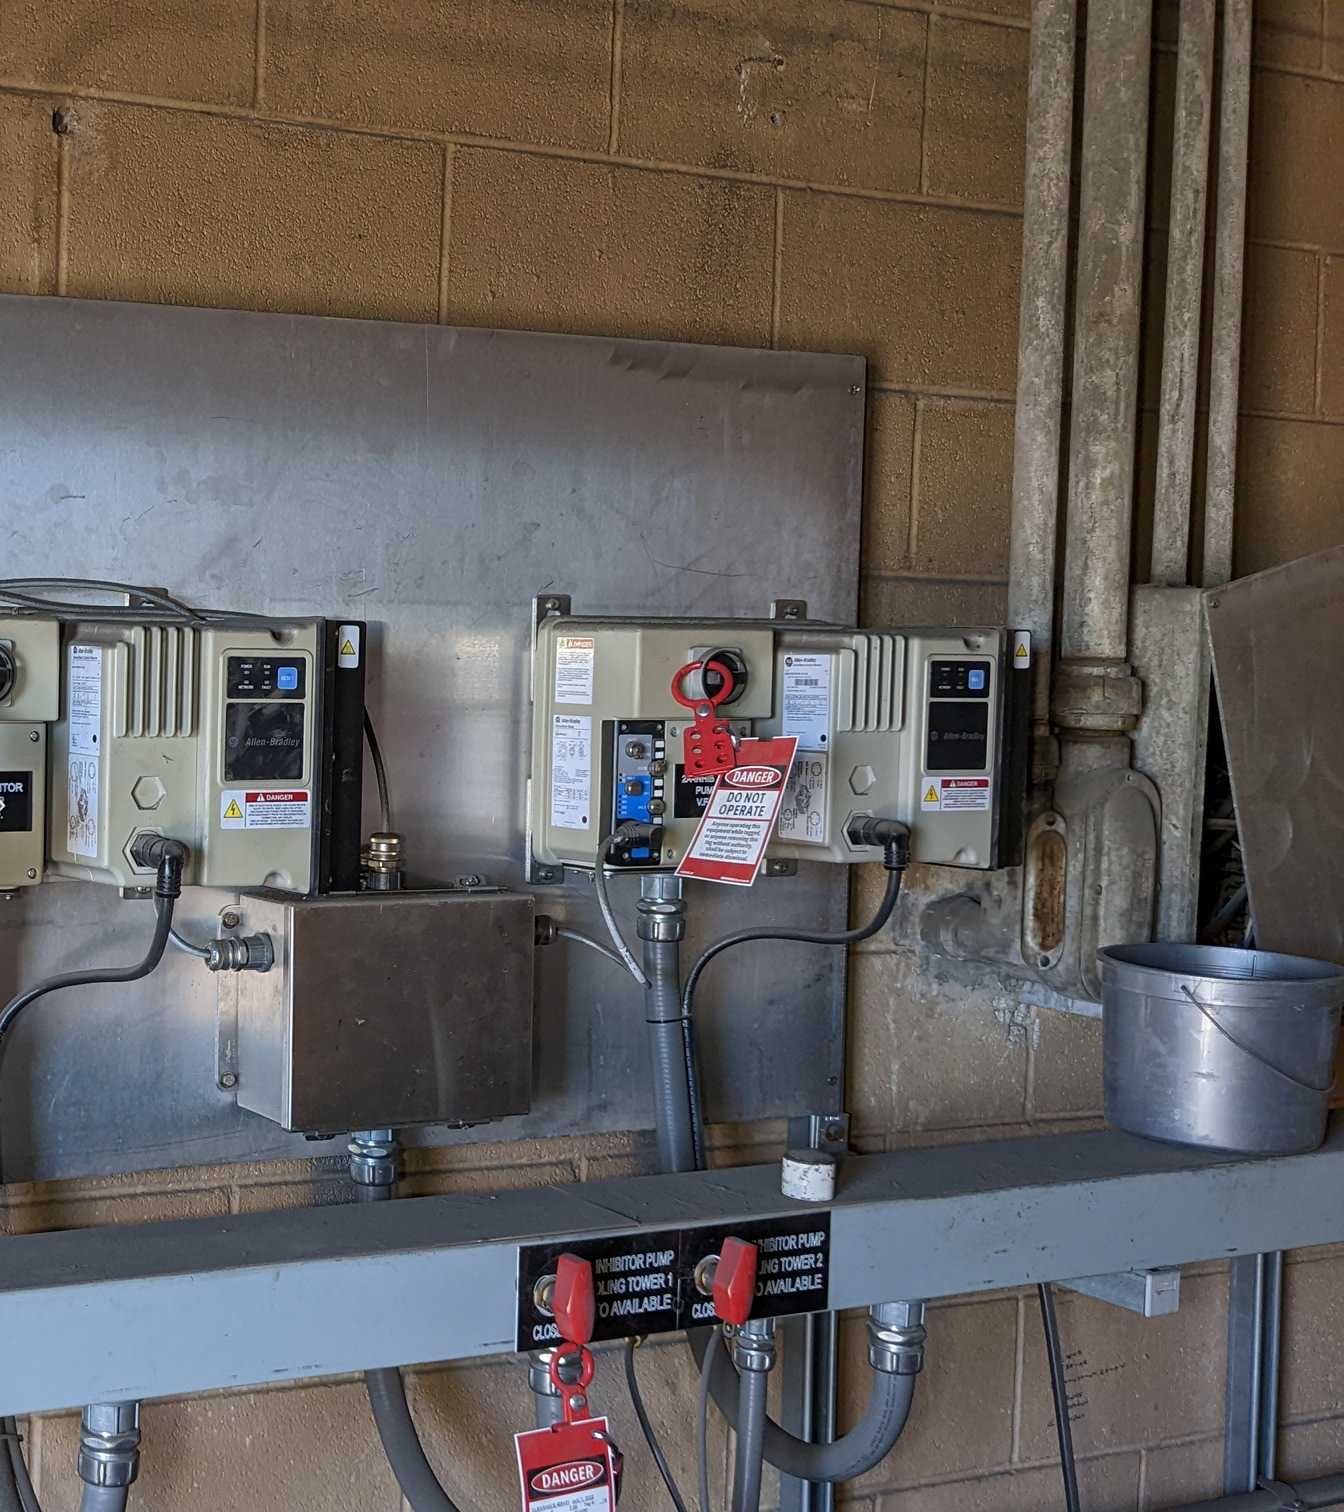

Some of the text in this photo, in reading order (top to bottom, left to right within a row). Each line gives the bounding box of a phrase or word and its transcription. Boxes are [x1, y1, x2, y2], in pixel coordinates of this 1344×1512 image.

[245, 737, 301, 747] Allen-Bradley
[732, 771, 775, 783] DANGER
[696, 786, 714, 795] PUM
[726, 792, 766, 804] DO NOT
[719, 804, 765, 817] OPERATE
[798, 1231, 825, 1249] PUMP
[595, 1250, 675, 1274] INHIBITOR PUMP
[780, 1253, 816, 1272] TOWER
[816, 1252, 824, 1268] 2
[627, 1273, 666, 1293] TOWER
[667, 1272, 673, 1287] 1
[764, 1274, 824, 1295] AVAILABLE
[610, 1294, 673, 1317] AVAILABLE
[532, 1323, 560, 1341] CLOS
[541, 1464, 595, 1489] DANGER
